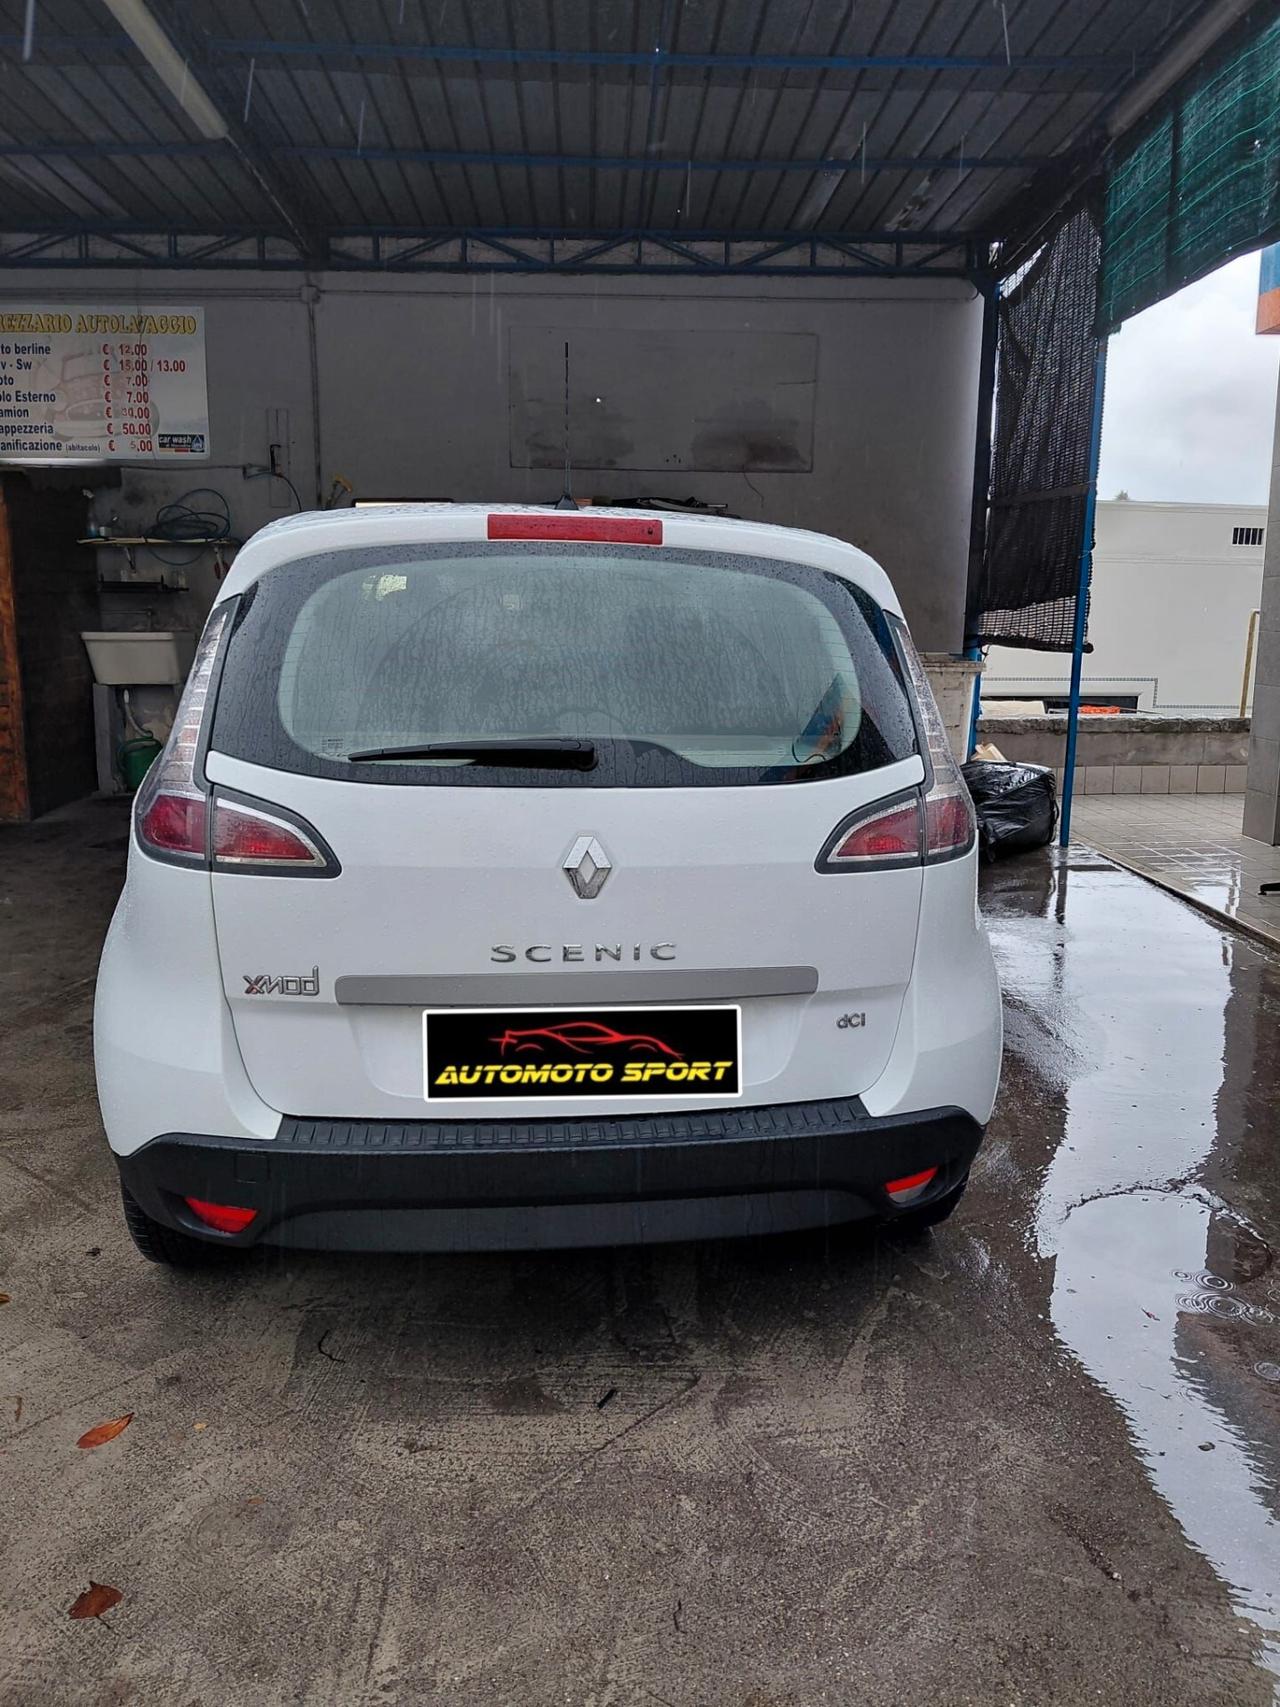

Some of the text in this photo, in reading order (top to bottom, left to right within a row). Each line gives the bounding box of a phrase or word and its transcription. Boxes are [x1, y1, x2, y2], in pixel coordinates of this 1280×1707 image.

[75, 314, 197, 335] AUTOLAVAGGIO
[14, 343, 51, 354] berline
[103, 344, 109, 355] €
[119, 344, 147, 355] 12.00
[16, 359, 32, 370] Sw
[103, 360, 110, 371] €
[157, 360, 186, 372] 13.00
[104, 375, 110, 386] €
[126, 375, 148, 387] 7.00
[15, 391, 56, 402] Esterno
[105, 391, 112, 403] €
[127, 391, 149, 403] 7.00
[106, 407, 112, 418] €
[121, 407, 150, 419] 30.00
[107, 423, 113, 435] €
[122, 423, 151, 435] 50.00
[0, 439, 62, 451] anificazione
[109, 440, 115, 452] €
[130, 440, 152, 452] 5.00
[172, 435, 191, 444] wash
[490, 942, 676, 963] SCENIC
